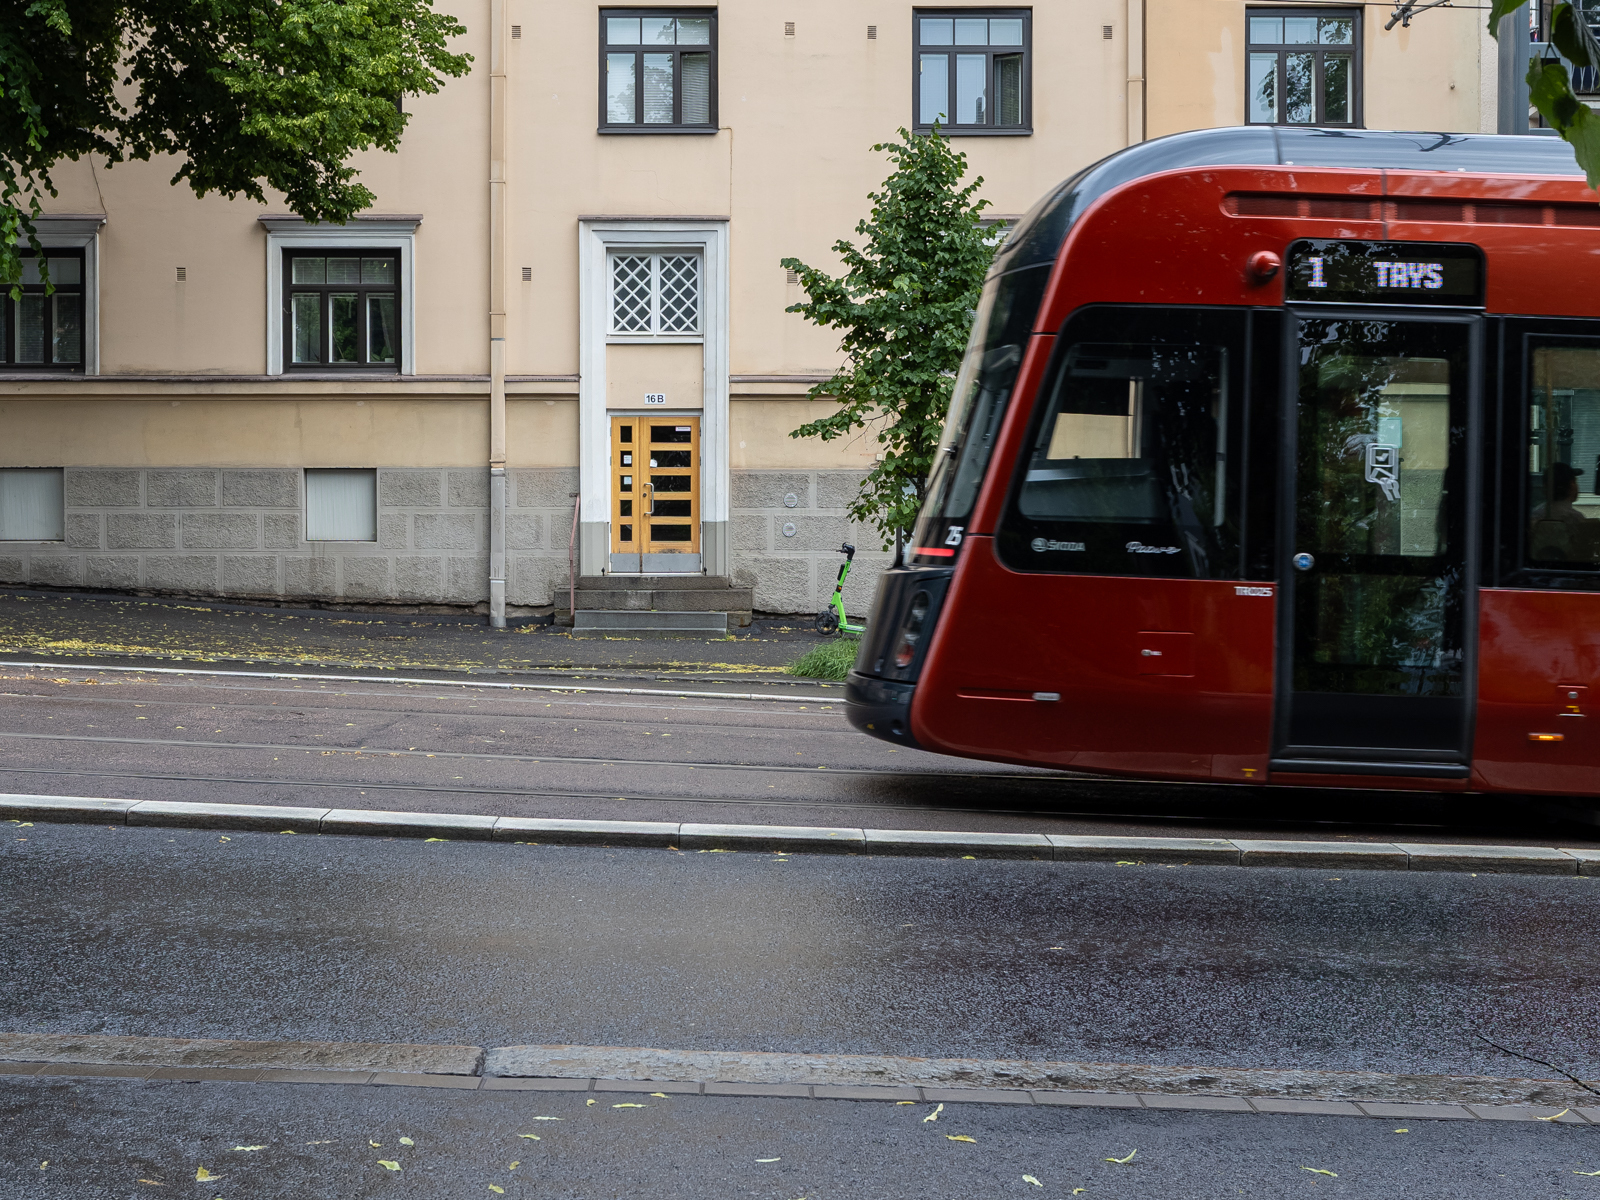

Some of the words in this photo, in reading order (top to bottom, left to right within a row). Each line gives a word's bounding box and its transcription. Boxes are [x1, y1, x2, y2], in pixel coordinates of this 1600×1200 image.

[1308, 257, 1327, 288] 1
[1373, 261, 1444, 289] TAYS
[646, 394, 656, 403] 16
[657, 394, 664, 403] B
[944, 525, 965, 546] 25
